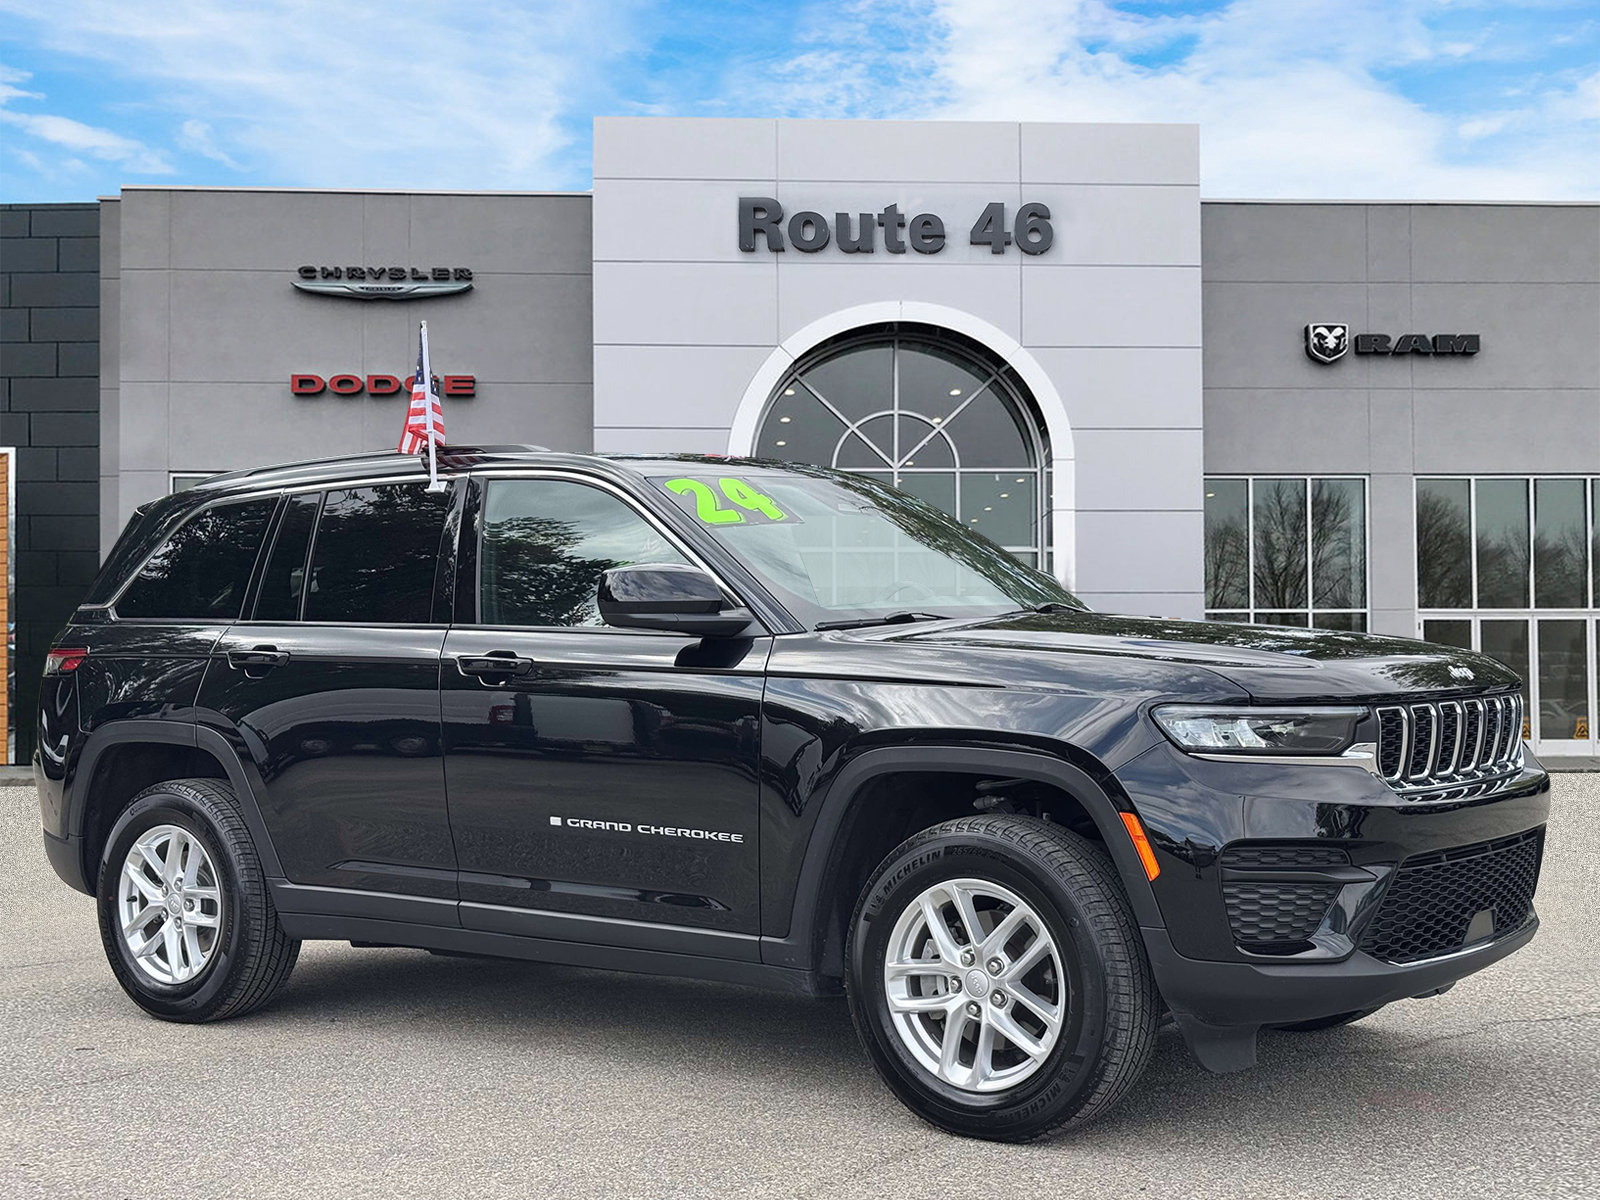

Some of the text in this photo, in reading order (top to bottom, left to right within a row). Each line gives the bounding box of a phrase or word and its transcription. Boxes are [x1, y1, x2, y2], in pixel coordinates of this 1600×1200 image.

[739, 197, 1054, 255] Route 46
[298, 266, 473, 281] CHRYSLER
[1354, 334, 1480, 356] RAM
[664, 478, 788, 525] 24
[566, 817, 744, 843] GRAND CHEROKEE
[883, 850, 942, 895] MICHELIN
